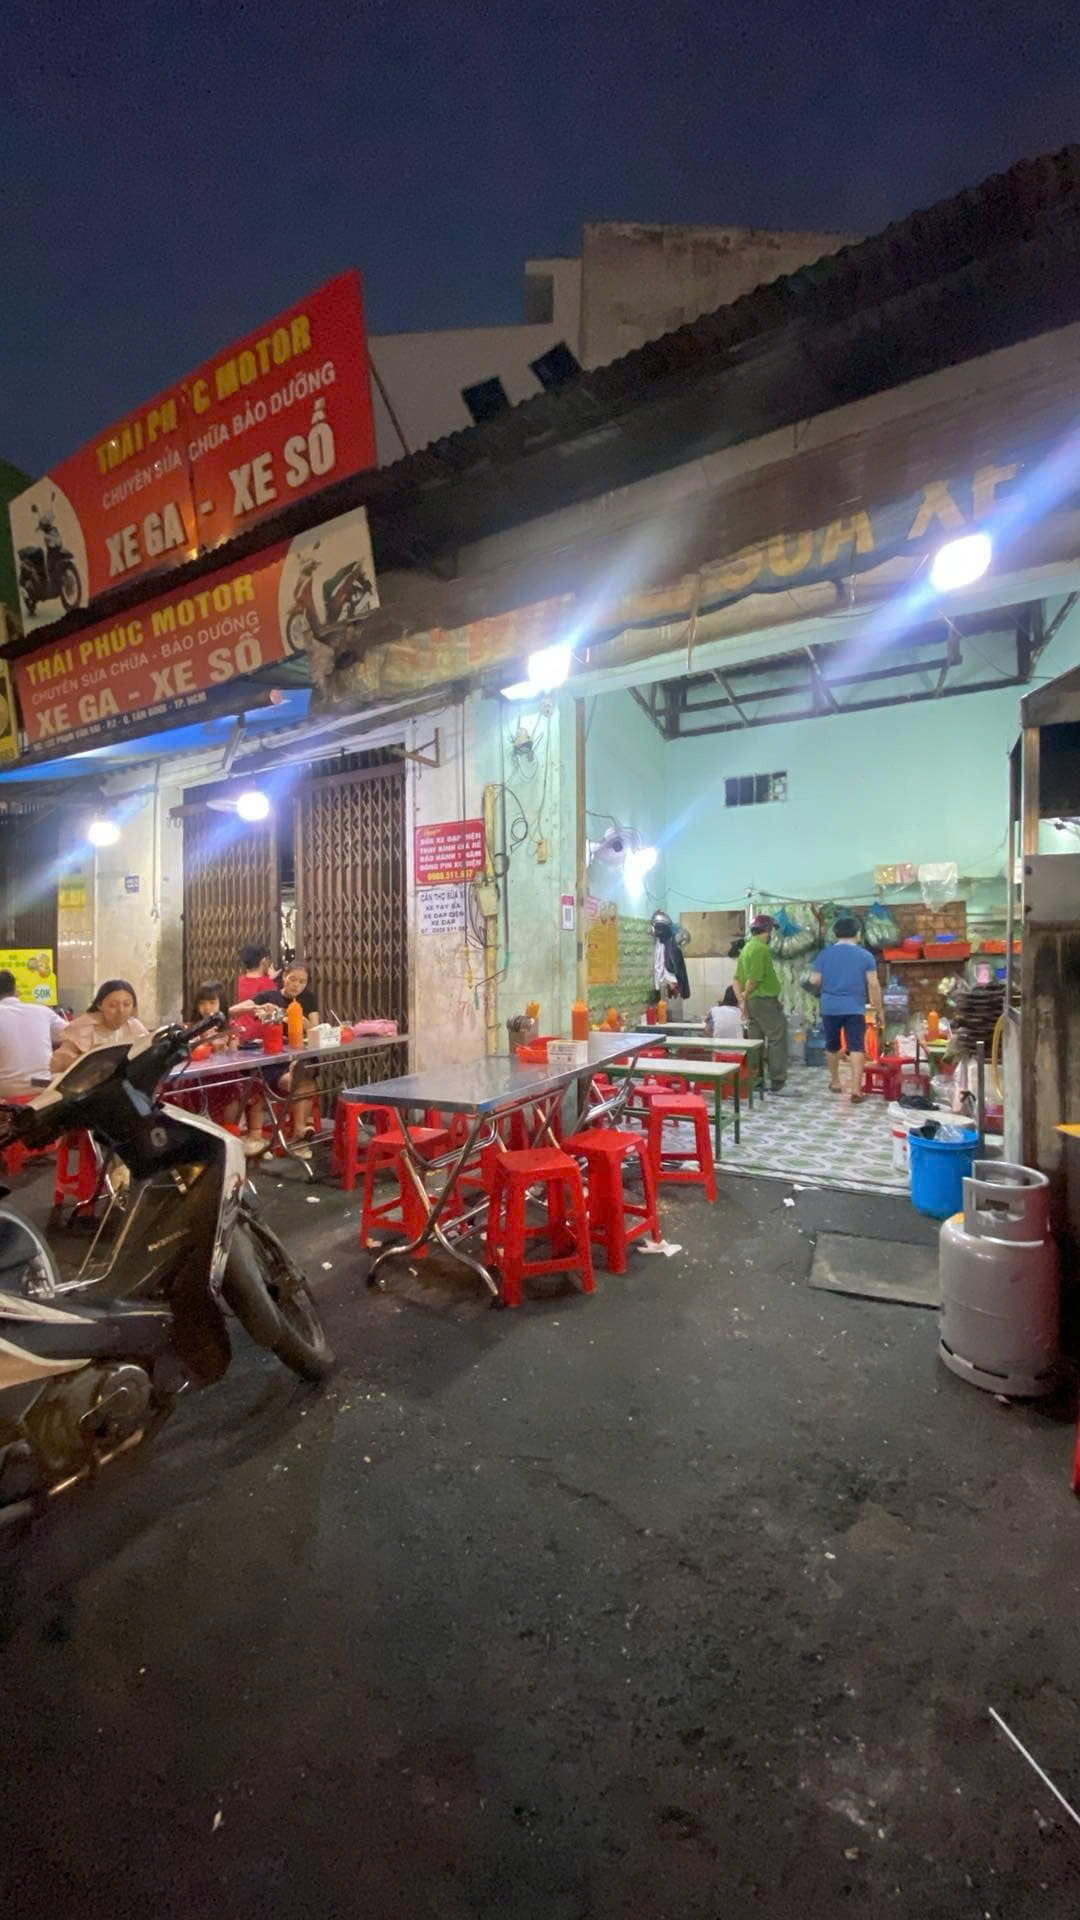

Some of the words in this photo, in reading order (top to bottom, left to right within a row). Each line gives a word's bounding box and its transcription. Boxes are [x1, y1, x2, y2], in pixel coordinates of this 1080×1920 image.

[147, 379, 211, 443] PHC
[215, 314, 312, 400] MOTOR
[233, 401, 267, 437] BẢO
[270, 361, 336, 415] DƯỠNG
[105, 523, 142, 577] XE
[143, 502, 186, 557] GA
[229, 452, 278, 516] XE
[284, 397, 336, 488] SỐ
[26, 649, 73, 686] THÁI
[79, 621, 144, 665] PHÚC
[152, 574, 255, 637] MOTOR
[36, 703, 72, 737] XE
[79, 688, 120, 723] GA
[150, 660, 197, 700] XE
[208, 626, 262, 682] SỐ
[161, 634, 194, 658] BẢO
